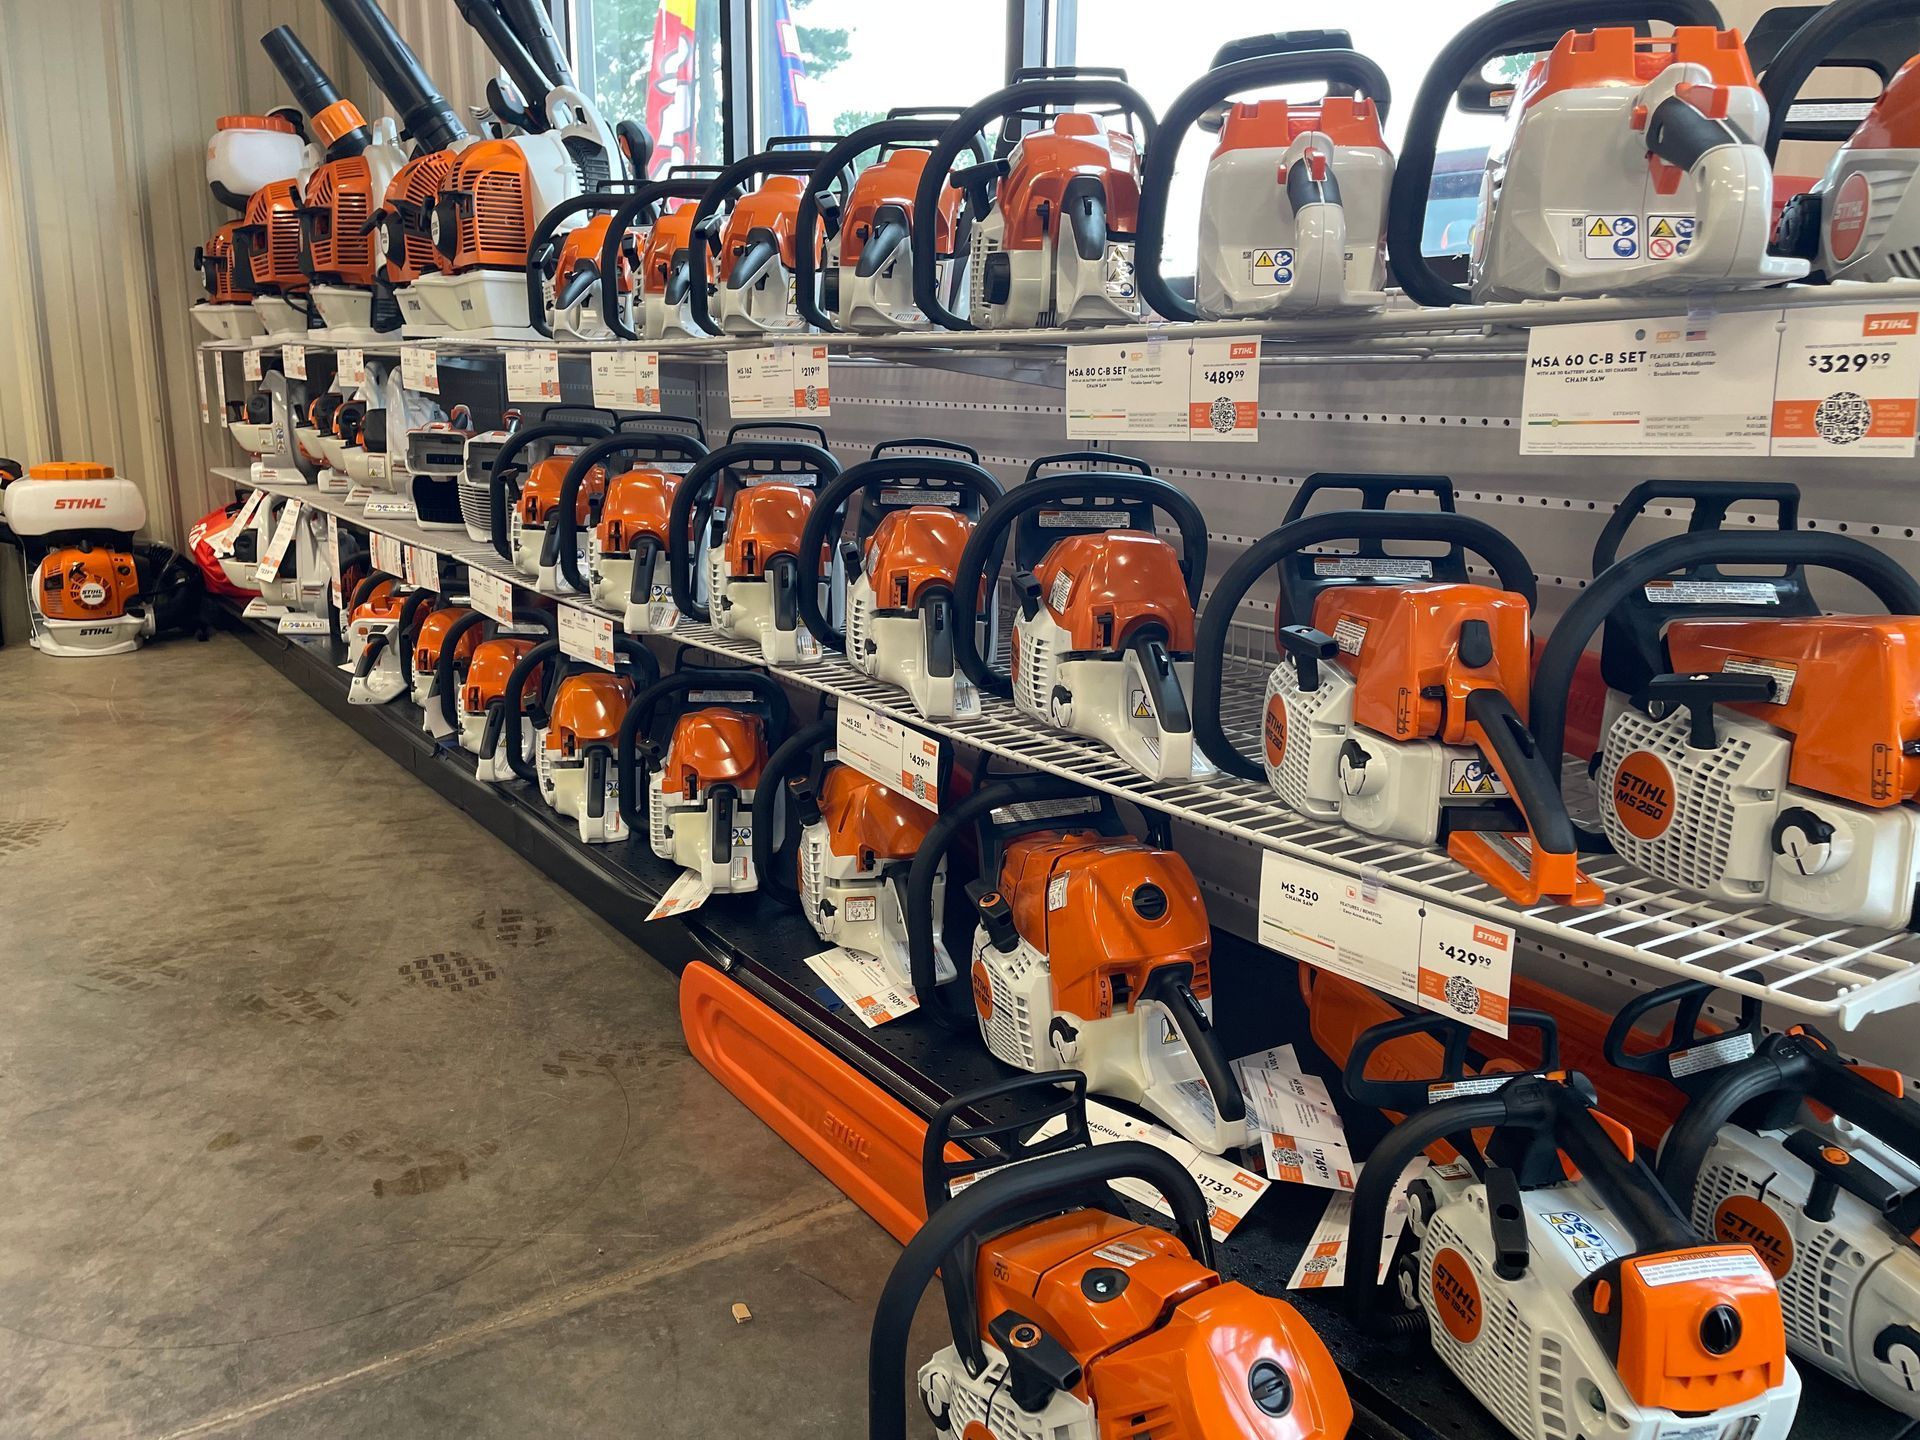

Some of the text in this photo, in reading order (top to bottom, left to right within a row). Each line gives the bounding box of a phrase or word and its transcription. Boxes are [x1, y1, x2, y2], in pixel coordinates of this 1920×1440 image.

[1868, 319, 1912, 330] STIHL
[1531, 351, 1648, 368] MSA 60 C-B SET
[1068, 366, 1127, 376] MSA 80 C-B SET
[54, 498, 106, 509] STIHL
[80, 627, 112, 636] STIHL
[1266, 712, 1284, 739] STIHL
[1618, 772, 1668, 807] STIHL
[1281, 882, 1318, 902] MS 250
[1284, 894, 1302, 903] CHAIN
[1476, 931, 1504, 946] STIHL
[824, 1111, 869, 1158] STIHL
[1087, 1120, 1120, 1139] MAGNUM
[1722, 1211, 1785, 1257] STIHL
[1434, 1264, 1476, 1318] STIHL
